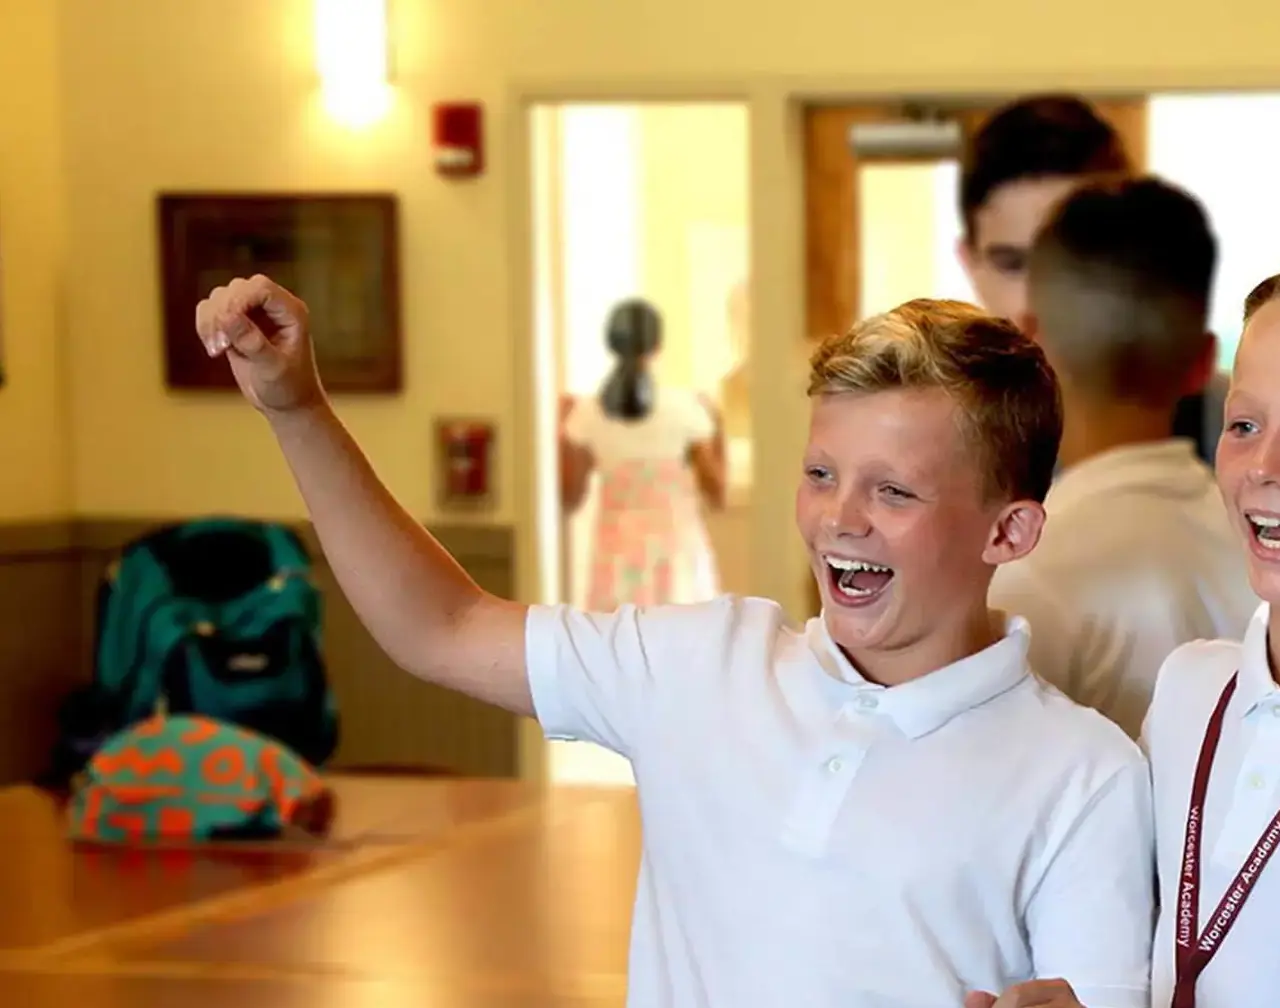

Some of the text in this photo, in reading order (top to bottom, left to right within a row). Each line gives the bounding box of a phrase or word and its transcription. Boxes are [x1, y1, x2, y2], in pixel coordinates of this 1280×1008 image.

[1177, 805, 1199, 947] Worcester Academy
[1199, 883, 1245, 951] Worcester
